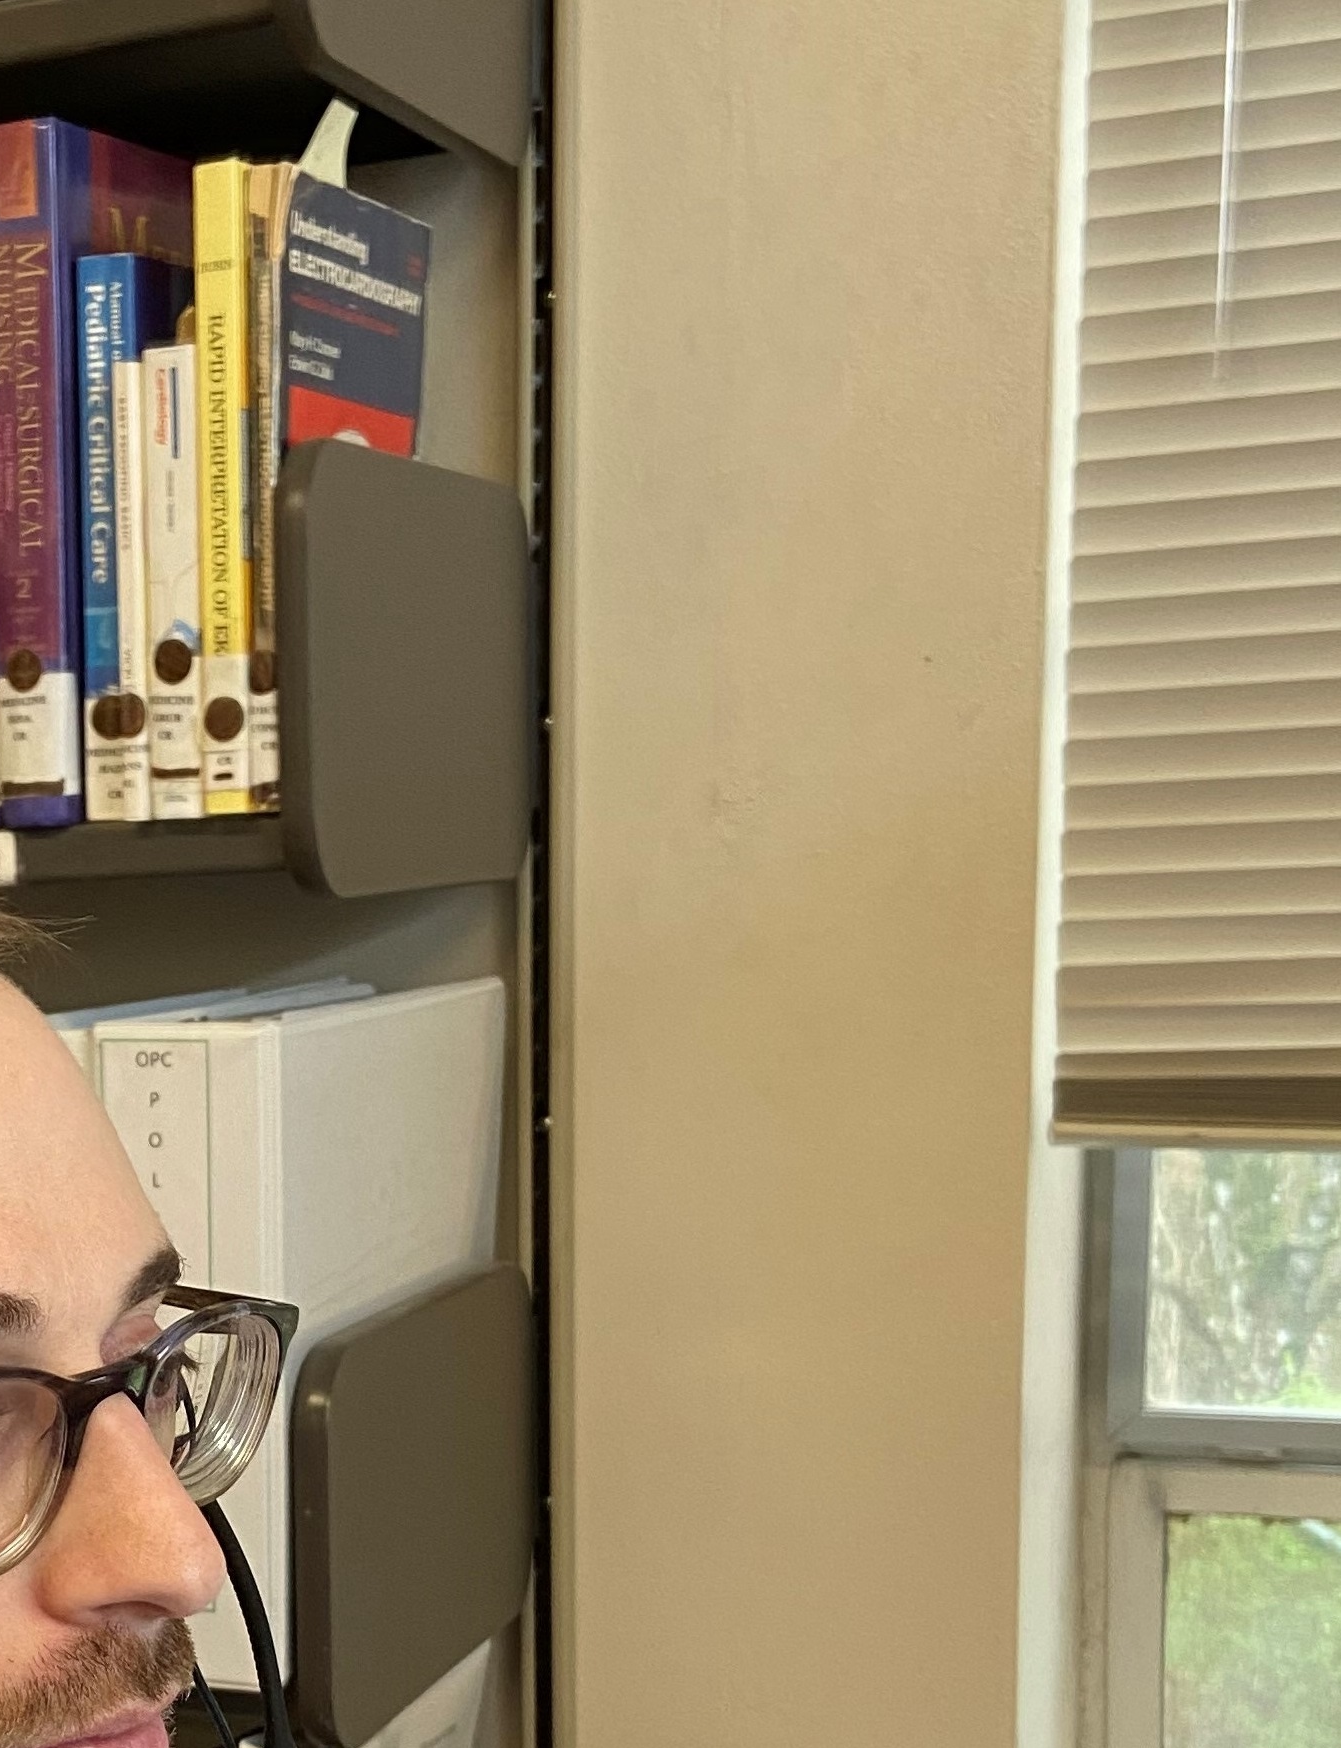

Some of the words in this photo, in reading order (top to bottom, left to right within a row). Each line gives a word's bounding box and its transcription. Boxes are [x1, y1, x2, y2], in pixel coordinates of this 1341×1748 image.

[108, 280, 126, 338] Manual
[84, 283, 113, 409] Pediatric
[207, 313, 227, 385] RAPID
[88, 415, 115, 513] Critical
[208, 390, 231, 584] INTERPRETATION
[90, 521, 117, 585] Care
[211, 589, 231, 617] OF
[135, 1051, 173, 1067] OPC
